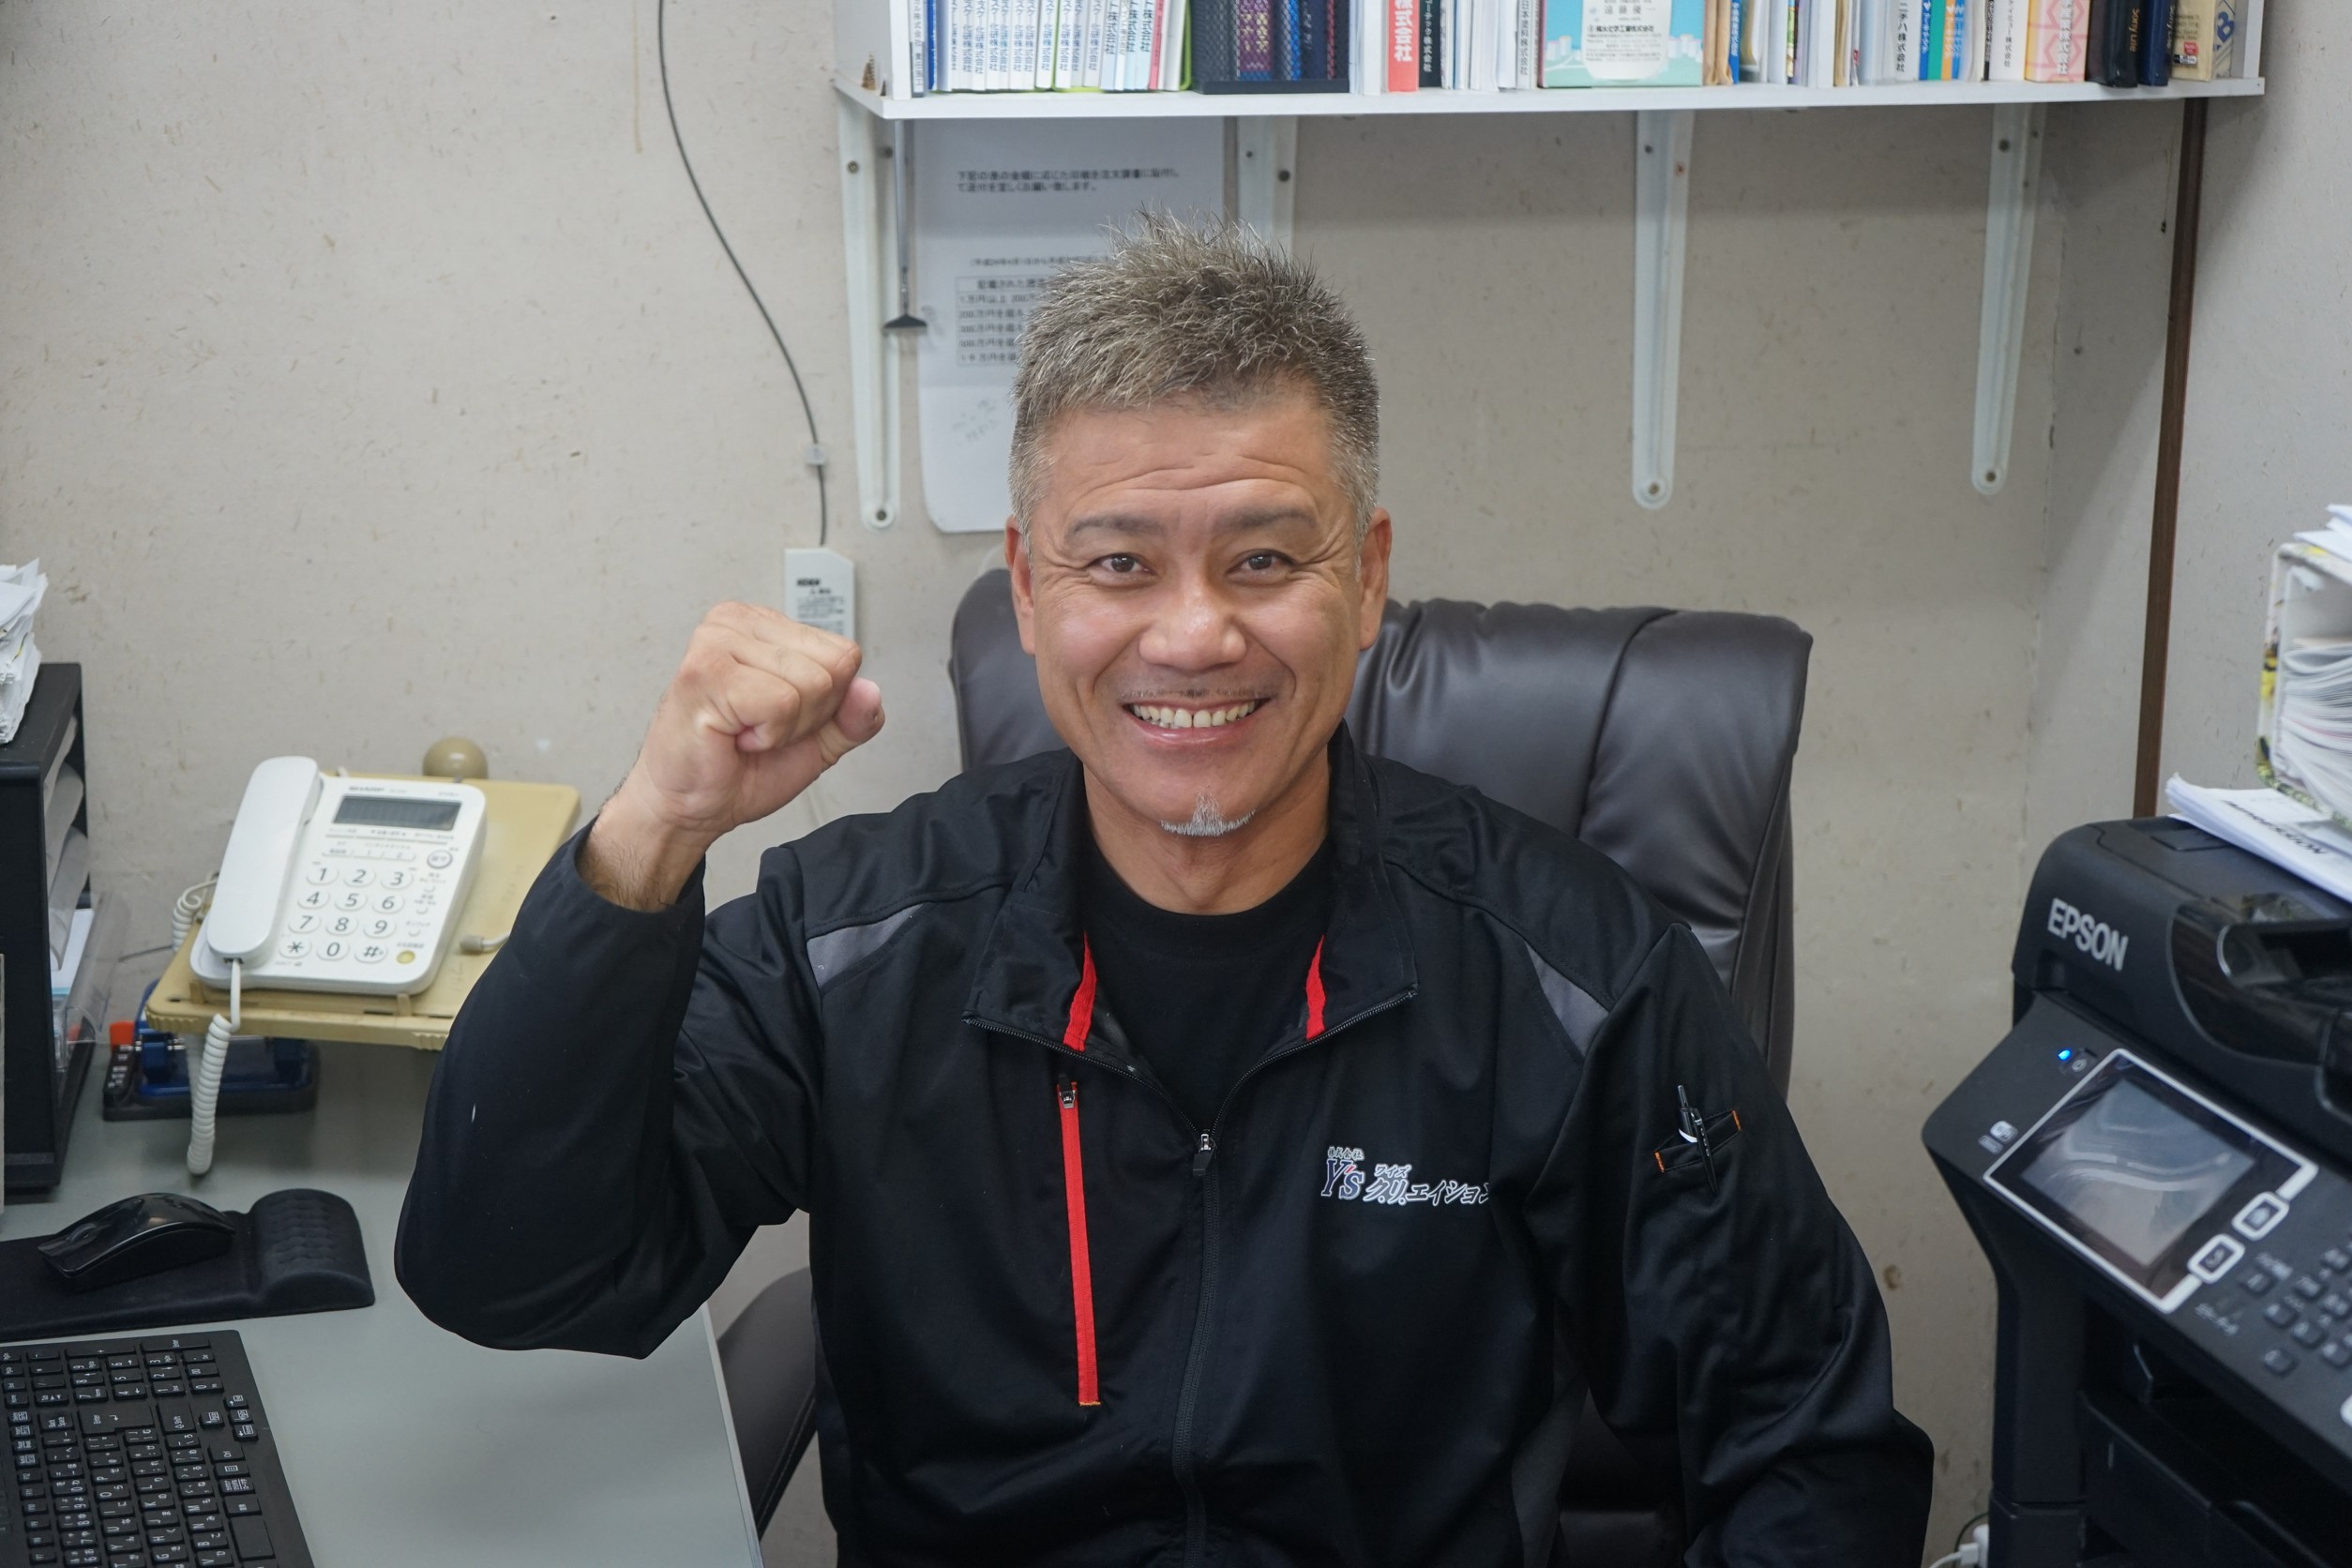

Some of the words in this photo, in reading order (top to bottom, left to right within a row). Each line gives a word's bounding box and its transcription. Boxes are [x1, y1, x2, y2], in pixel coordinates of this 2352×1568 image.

[320, 867, 327, 881] 1
[352, 869, 367, 883] 2
[390, 872, 404, 886] 3
[307, 892, 320, 905] 4
[345, 893, 359, 907] 5
[382, 896, 396, 910] 6
[300, 915, 313, 929] 7
[335, 917, 349, 932] 8
[373, 920, 388, 934] 9
[2047, 897, 2129, 972] EPSON
[326, 942, 340, 957] 0
[1327, 1146, 1364, 1161] 株式会社
[1374, 1163, 1412, 1179] ワイズ
